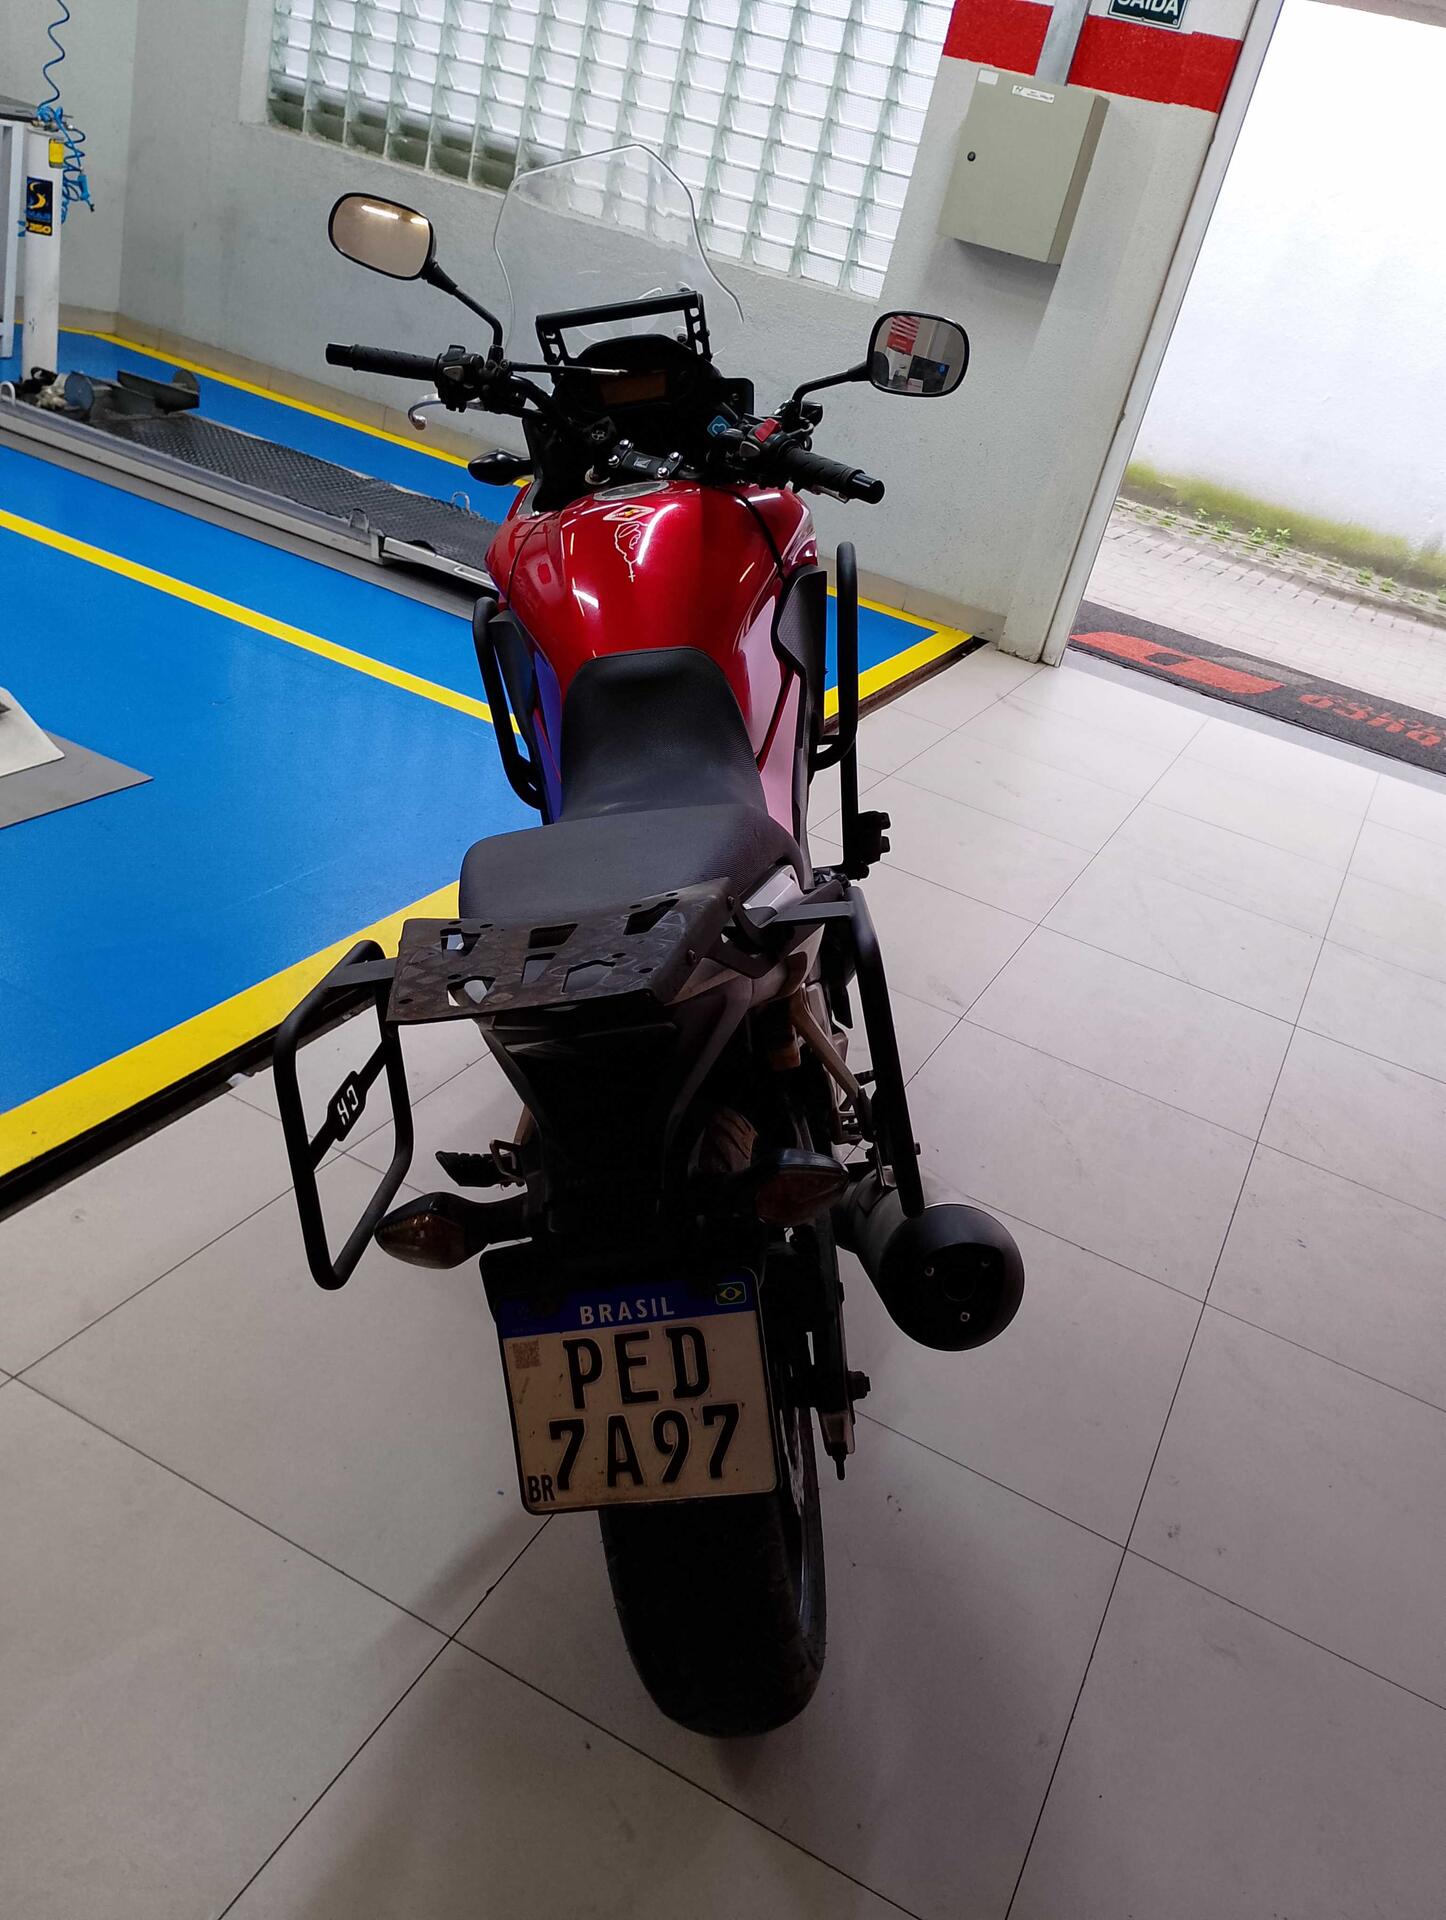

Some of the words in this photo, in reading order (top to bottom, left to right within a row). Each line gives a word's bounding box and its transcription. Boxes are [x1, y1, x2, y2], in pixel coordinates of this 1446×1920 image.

[579, 1296, 675, 1325] BRASIL
[561, 1325, 711, 1409] PED
[548, 1402, 741, 1491] 7A97
[526, 1473, 556, 1504] BR
